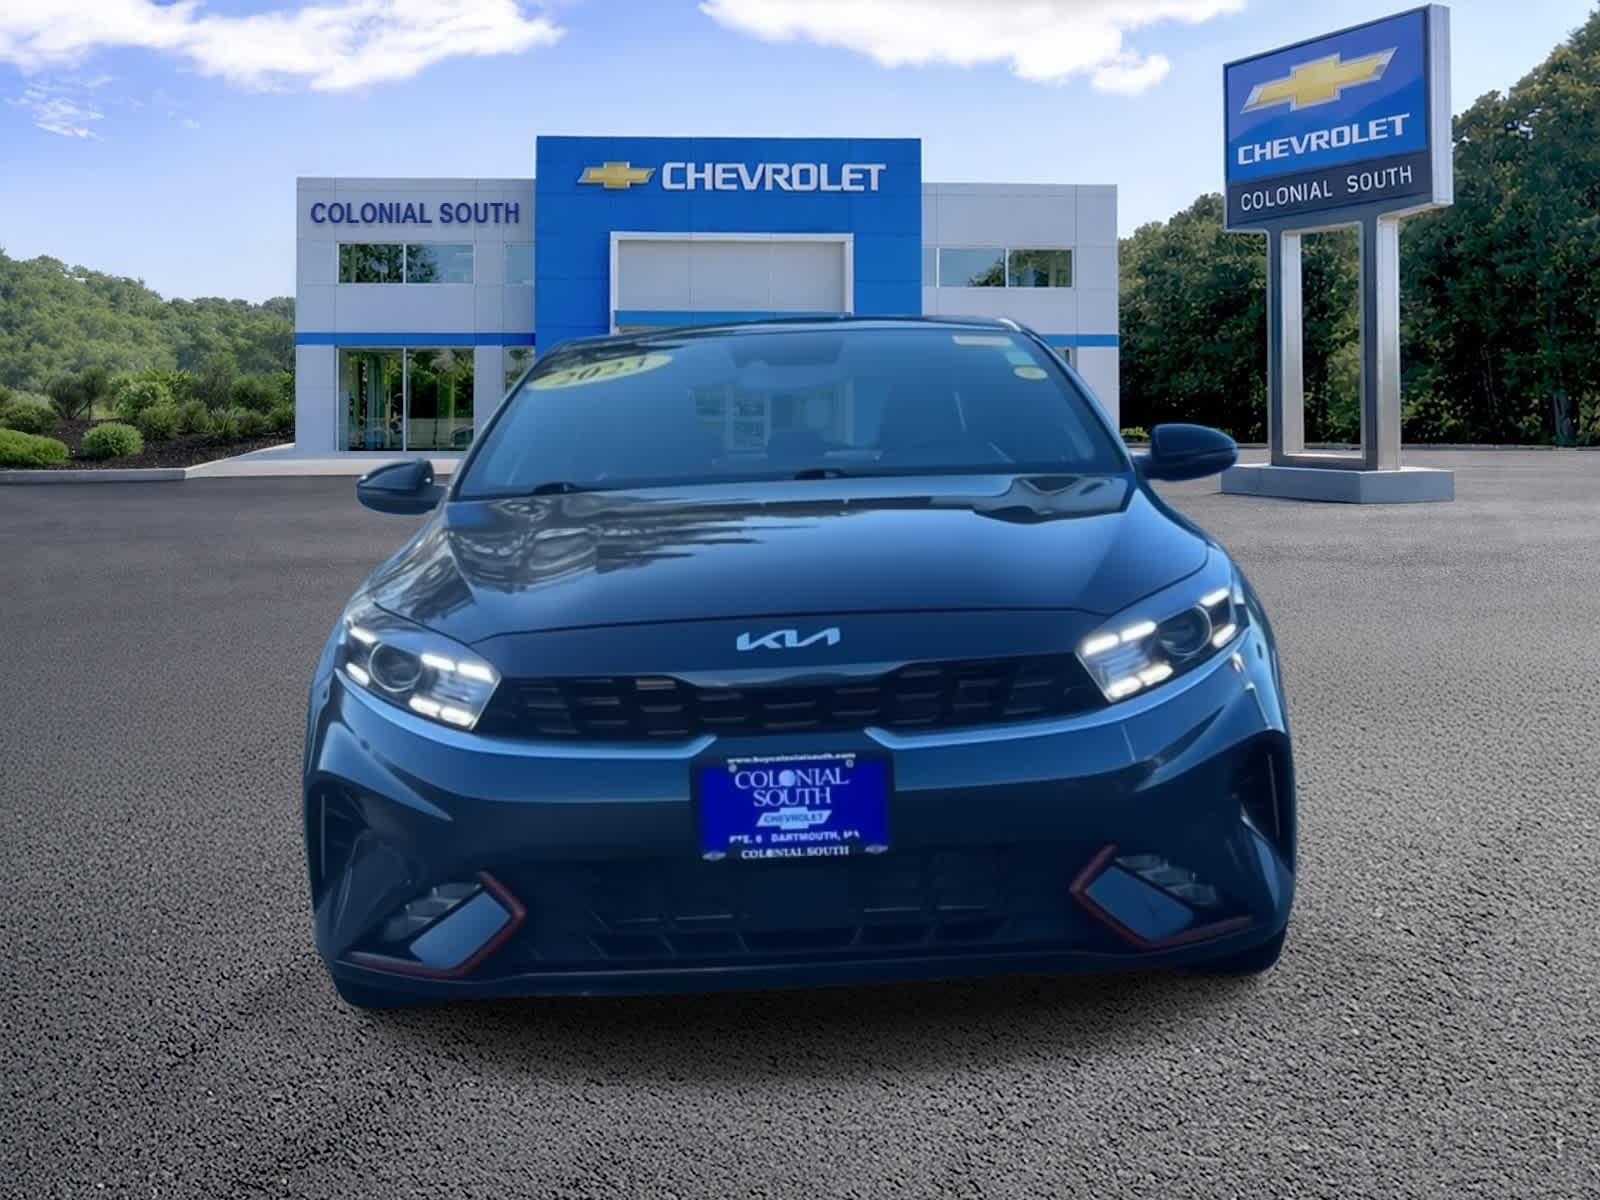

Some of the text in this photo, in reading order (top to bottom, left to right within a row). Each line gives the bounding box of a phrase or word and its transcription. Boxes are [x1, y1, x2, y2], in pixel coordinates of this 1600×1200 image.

[1237, 113, 1410, 165] CHEVROLET
[662, 161, 887, 192] CHEVROLET
[1240, 164, 1413, 212] COLONIAL SOUTH
[310, 202, 520, 224] COLONIAL SOUTH
[736, 627, 841, 651] KIA
[734, 767, 850, 789] COLONIAL
[753, 787, 832, 807] SOUTH
[763, 812, 824, 824] CHEVROLET
[741, 845, 850, 860] COLONIAL SOUTH
